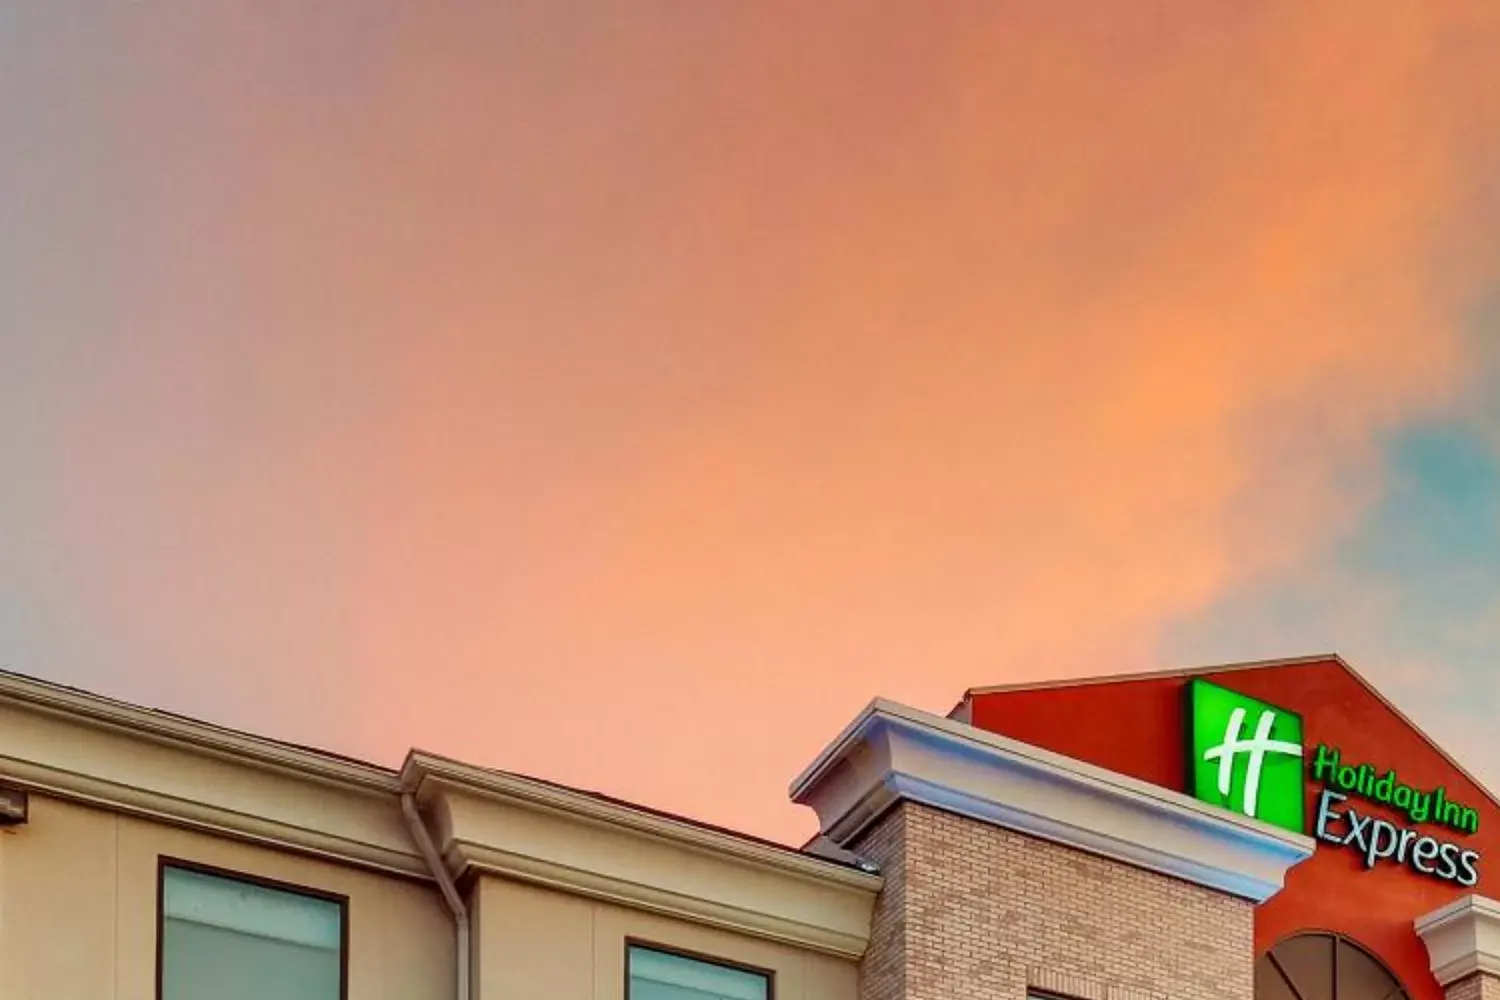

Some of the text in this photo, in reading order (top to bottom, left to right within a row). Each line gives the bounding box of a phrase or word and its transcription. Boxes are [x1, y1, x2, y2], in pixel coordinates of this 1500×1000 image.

[1204, 707, 1303, 817] H
[1314, 745, 1478, 832] Holiday Inn
[1317, 790, 1480, 886] Express
